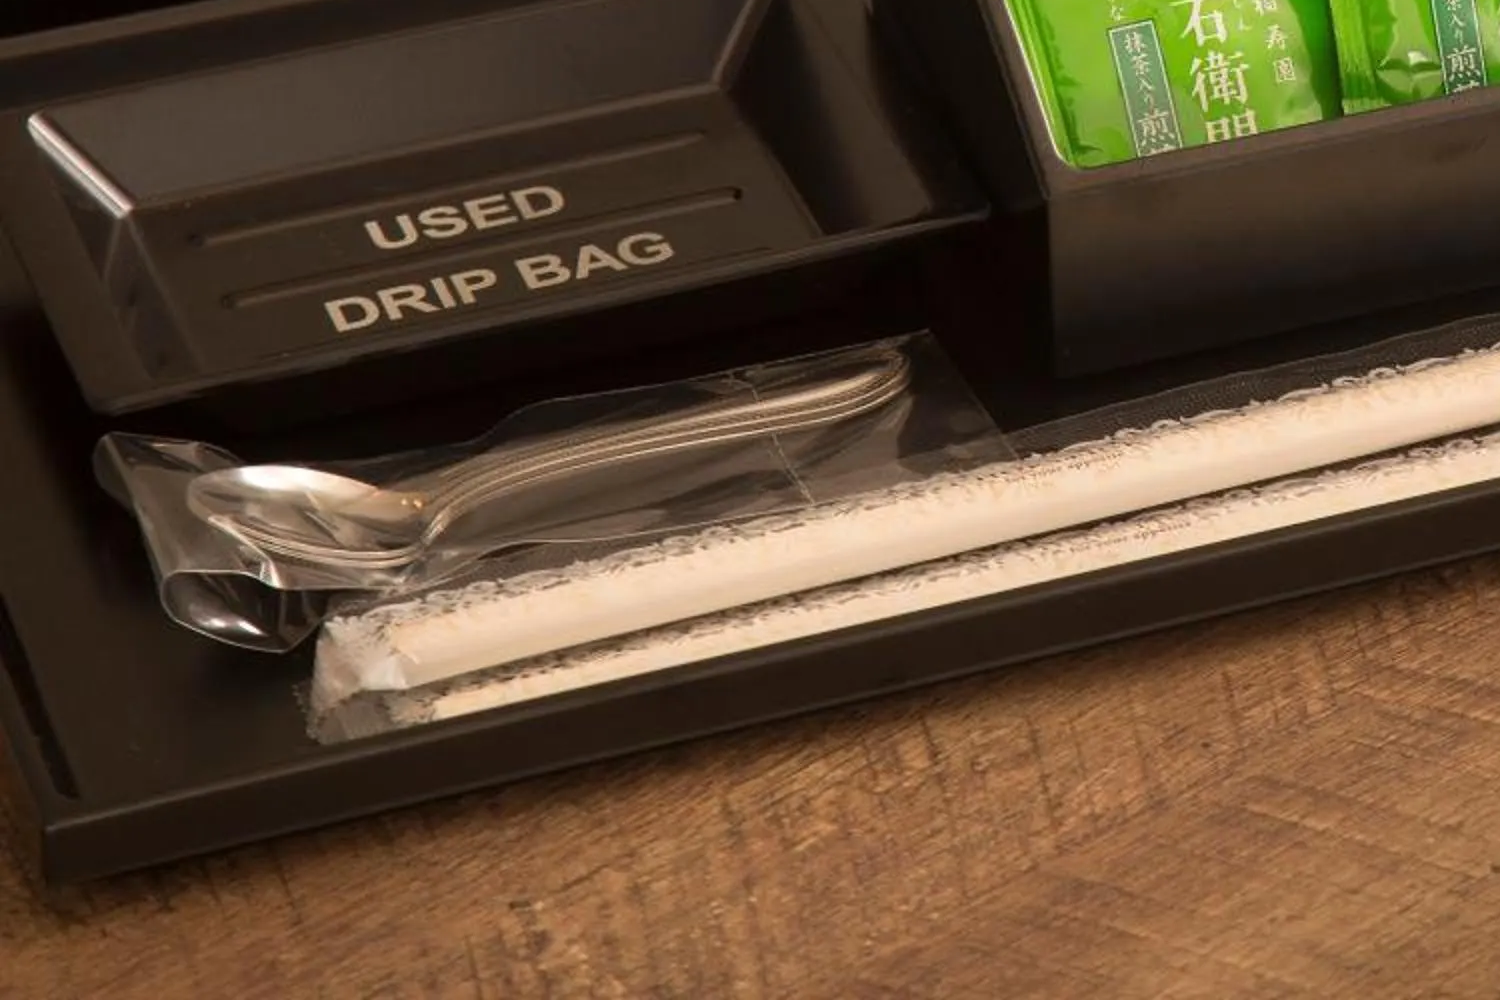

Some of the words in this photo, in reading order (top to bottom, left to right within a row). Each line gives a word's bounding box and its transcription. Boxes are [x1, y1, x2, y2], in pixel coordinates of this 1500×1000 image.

[1124, 31, 1176, 156] 抹茶入り煎
[364, 185, 565, 250] USED
[325, 268, 497, 333] DRIP
[514, 231, 675, 290] BAG
